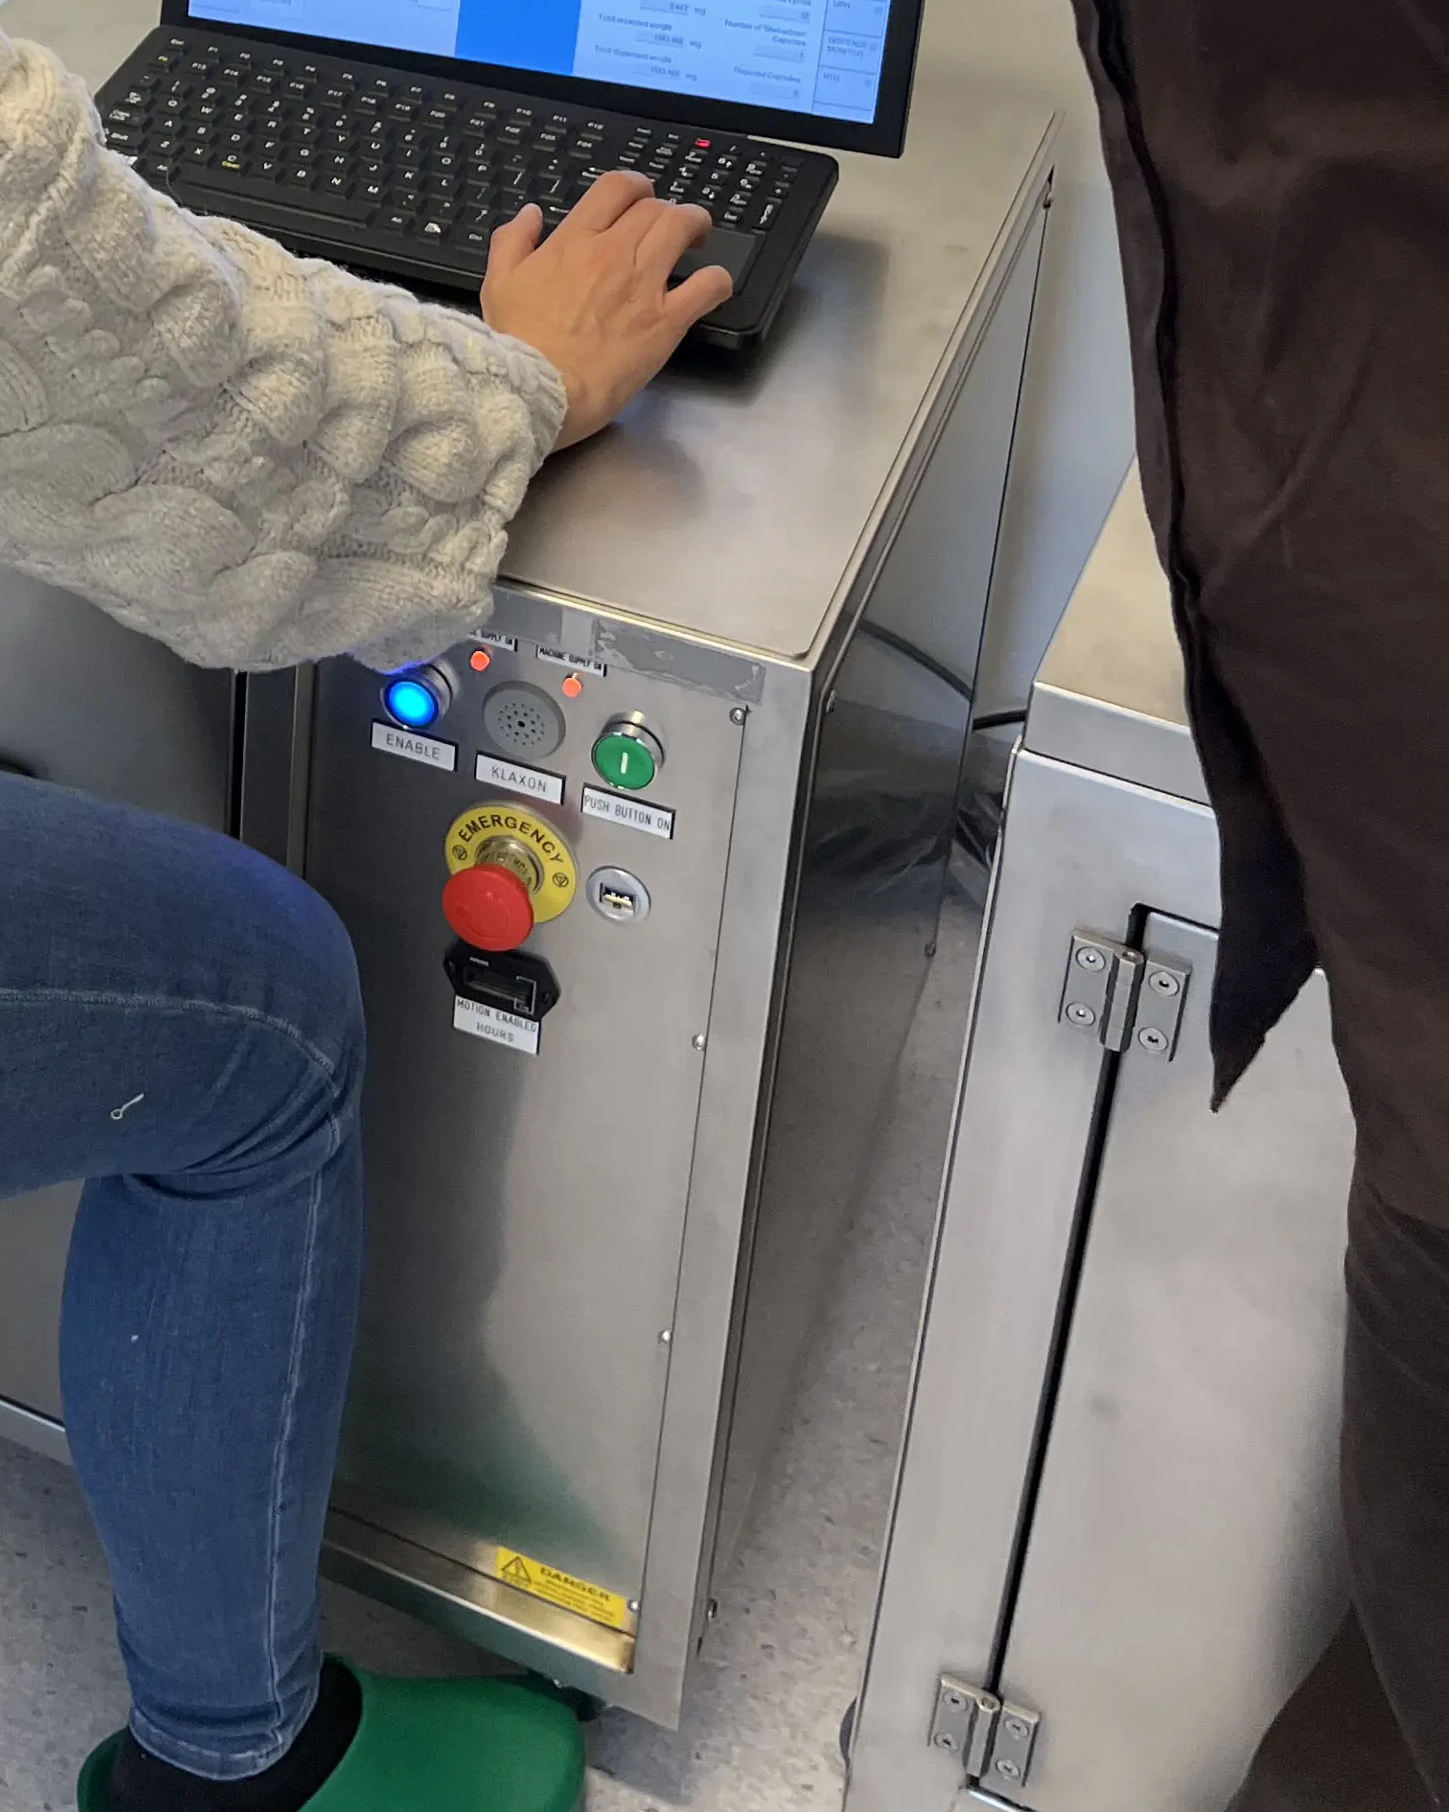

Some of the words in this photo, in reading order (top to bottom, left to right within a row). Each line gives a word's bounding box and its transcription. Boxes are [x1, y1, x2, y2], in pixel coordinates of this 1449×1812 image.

[386, 732, 442, 761] ENABLE
[491, 765, 547, 794] KLAXON
[584, 794, 611, 813] PUSH
[614, 803, 653, 828] BUTTON
[656, 813, 671, 833] ON
[458, 814, 564, 863] EMERGENCY
[457, 998, 491, 1018] MOTION
[495, 1011, 538, 1033] ENABLED
[476, 1021, 515, 1043] HOURS
[540, 1567, 611, 1602] DANGER
